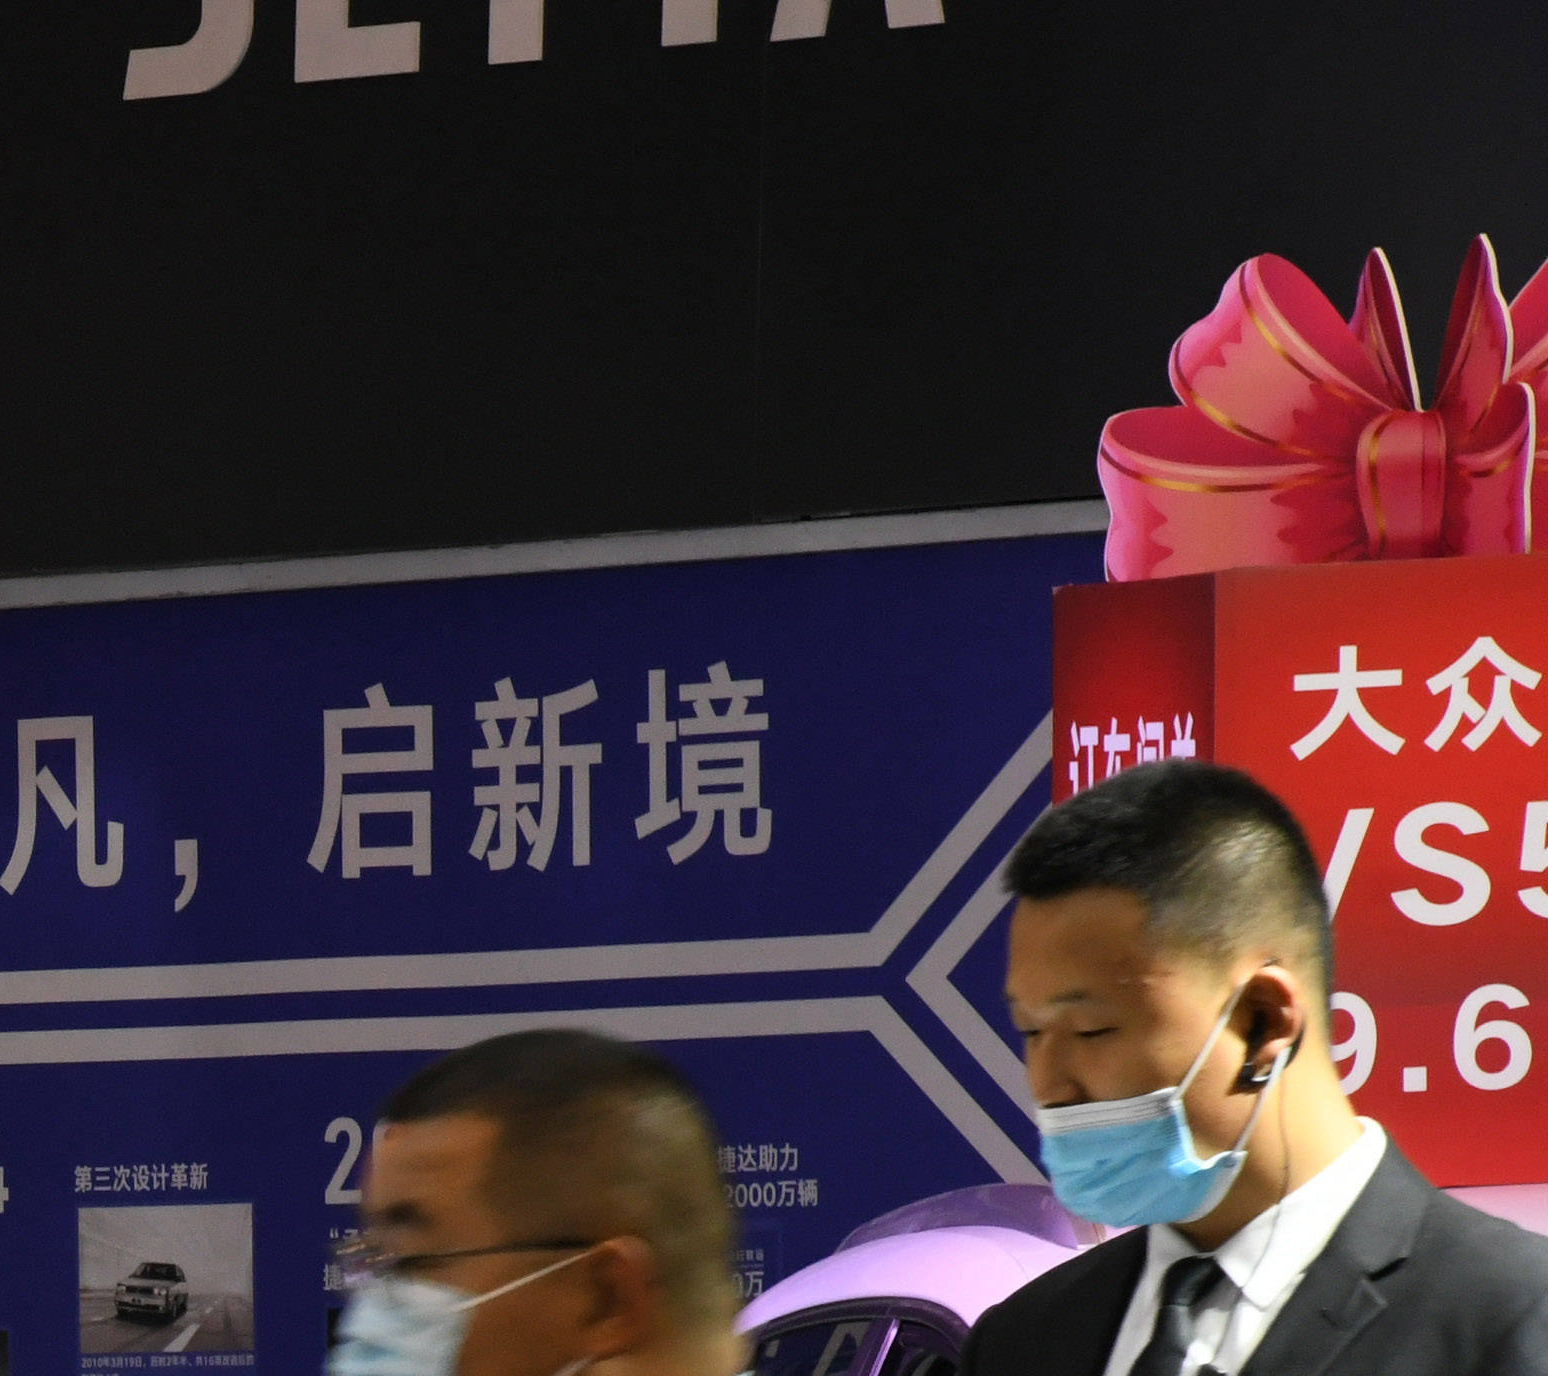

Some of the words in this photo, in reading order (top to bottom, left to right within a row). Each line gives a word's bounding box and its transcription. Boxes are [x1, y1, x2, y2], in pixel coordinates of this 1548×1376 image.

[1291, 636, 1544, 762] 大众
[74, 1163, 209, 1193] 第三次设计革新
